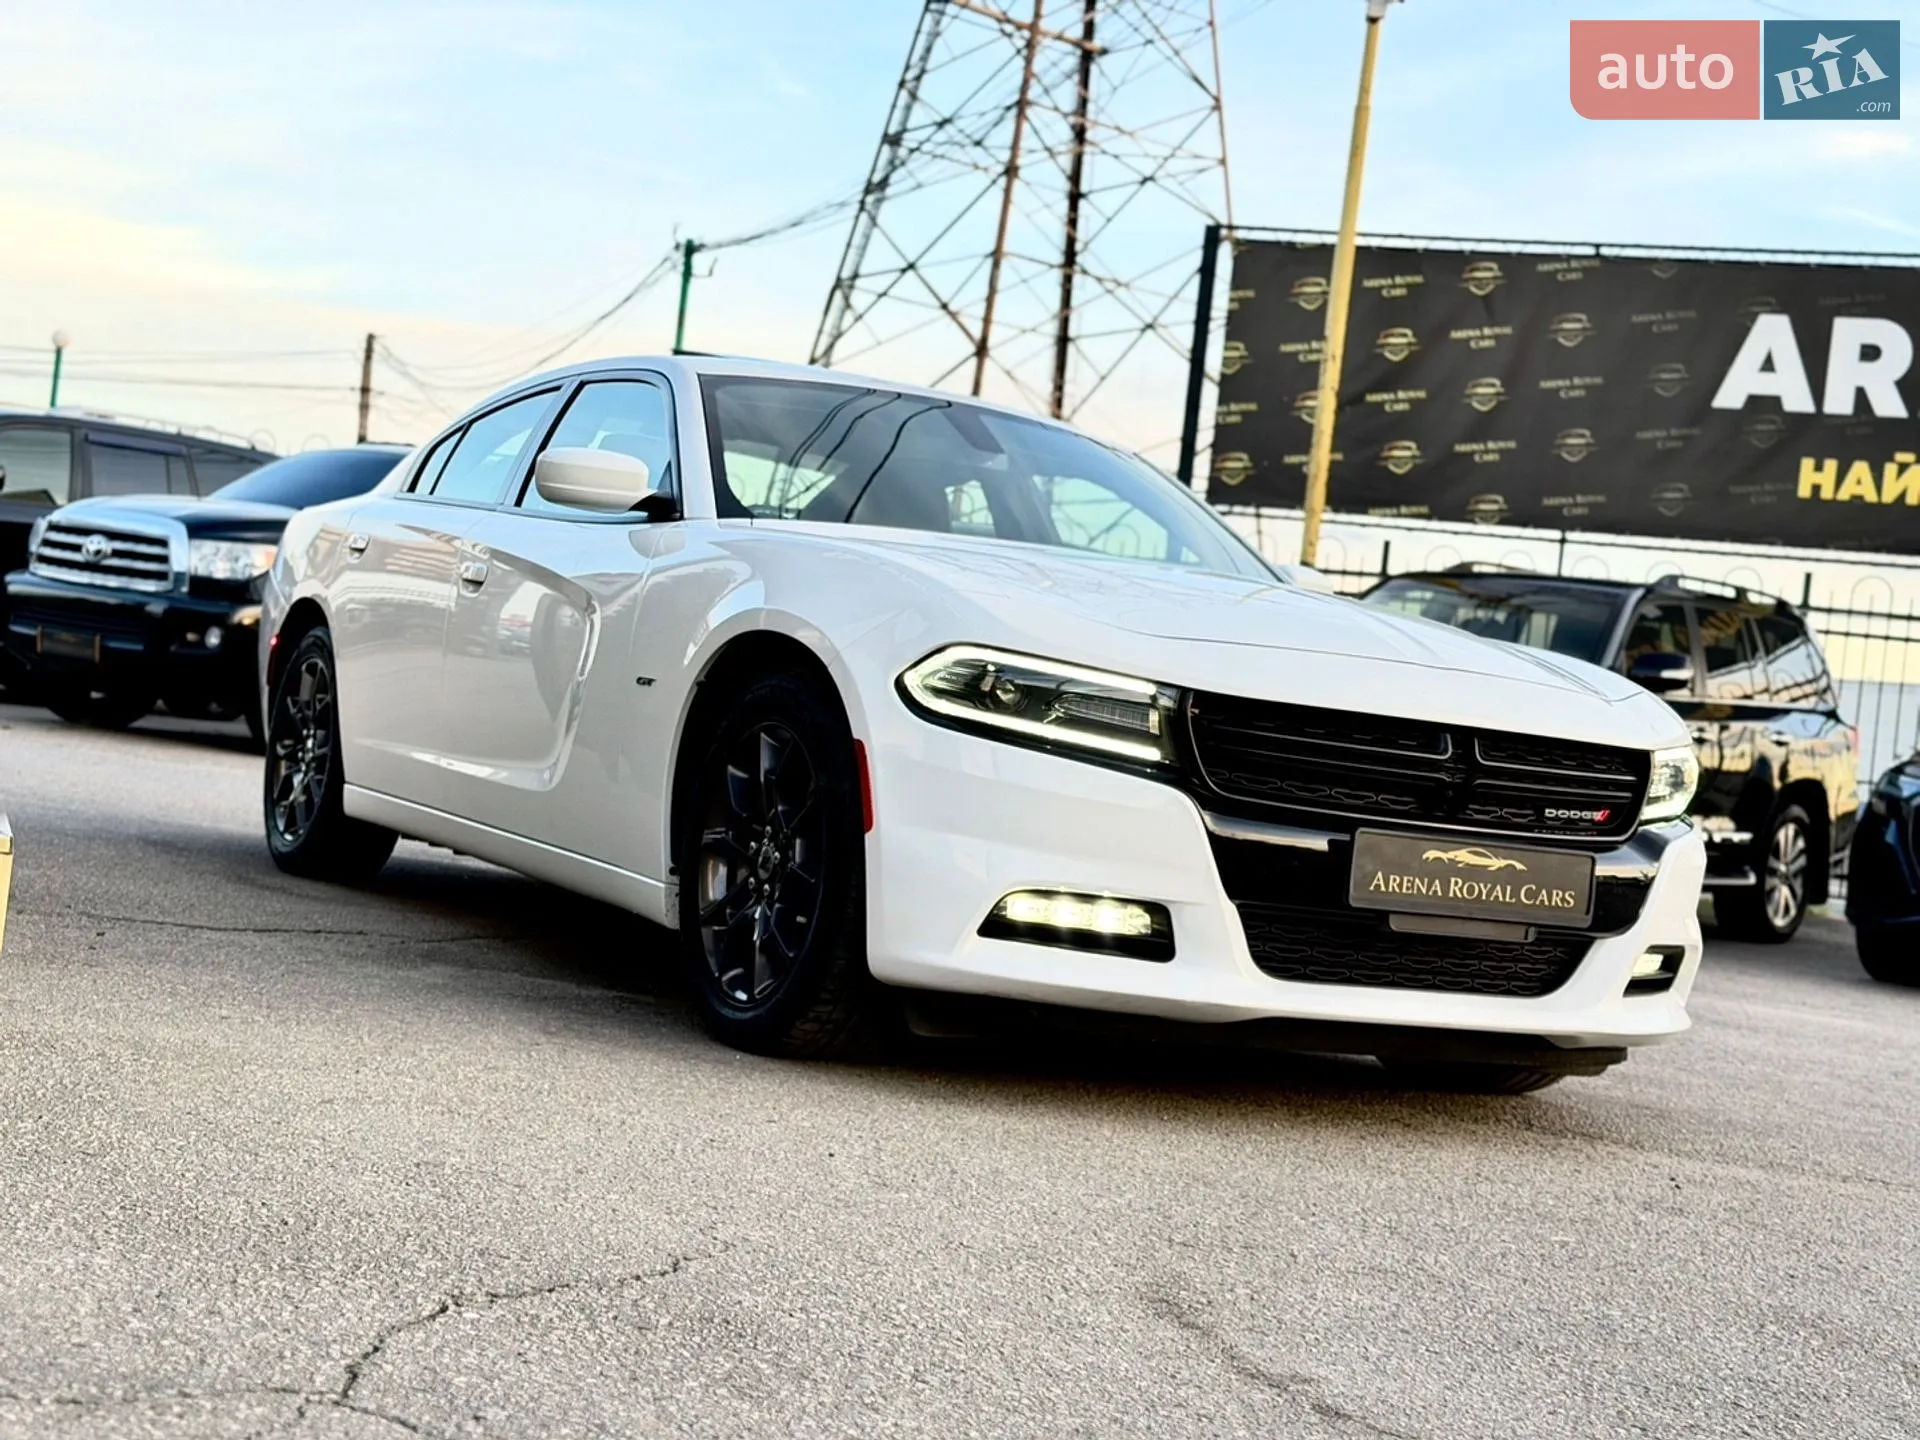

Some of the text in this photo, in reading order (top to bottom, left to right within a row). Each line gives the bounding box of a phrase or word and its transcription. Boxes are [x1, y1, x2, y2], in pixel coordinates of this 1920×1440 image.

[1710, 312, 1920, 419] AR
[1545, 808, 1603, 820] DODGE
[1369, 871, 1575, 908] ARENA ROYAL CARS
